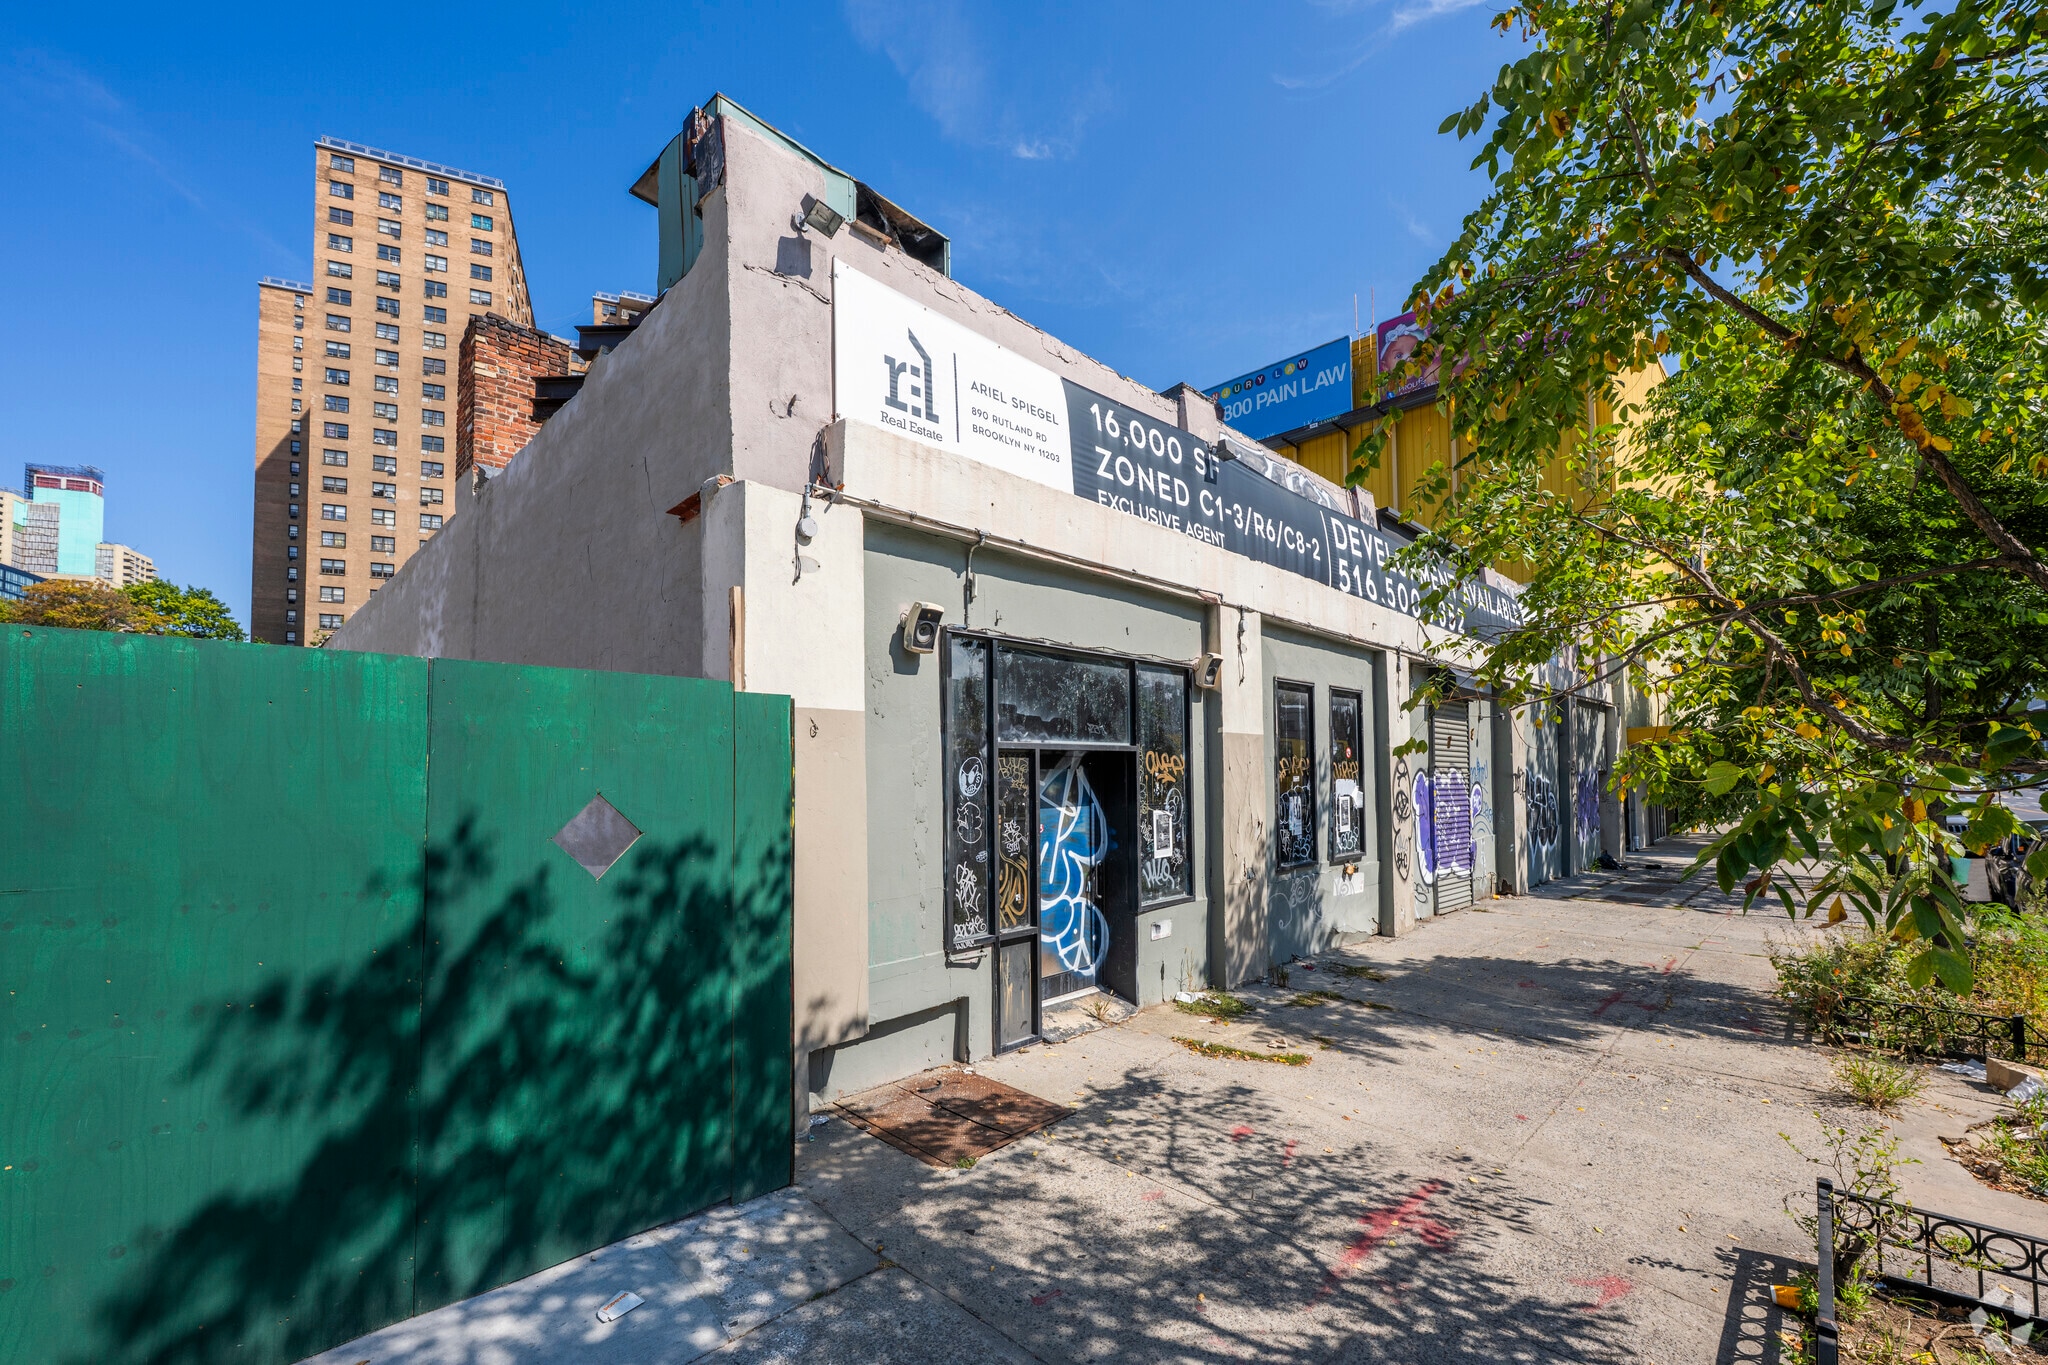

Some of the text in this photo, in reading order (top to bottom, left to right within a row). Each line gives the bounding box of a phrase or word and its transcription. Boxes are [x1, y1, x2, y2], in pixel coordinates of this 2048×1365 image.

[970, 380, 1059, 425] ARIEL SPIEGEL
[1211, 358, 1308, 401] NJURY LAW
[1256, 380, 1297, 410] PAIN
[1302, 362, 1347, 395] LAW
[880, 410, 943, 442] Real Estate
[971, 406, 1047, 442] 890 RUTLAND RD
[972, 424, 1060, 463] BROOKLYN NY 11203
[1090, 403, 1220, 480] 16,000 SF
[1095, 445, 1321, 561] ZONED C1-3/R6/C8-2
[1097, 489, 1225, 548] EXCLUSIVE AGENT
[1330, 517, 1458, 599] DEVELMENT
[1462, 580, 1521, 626] AVAILABLE
